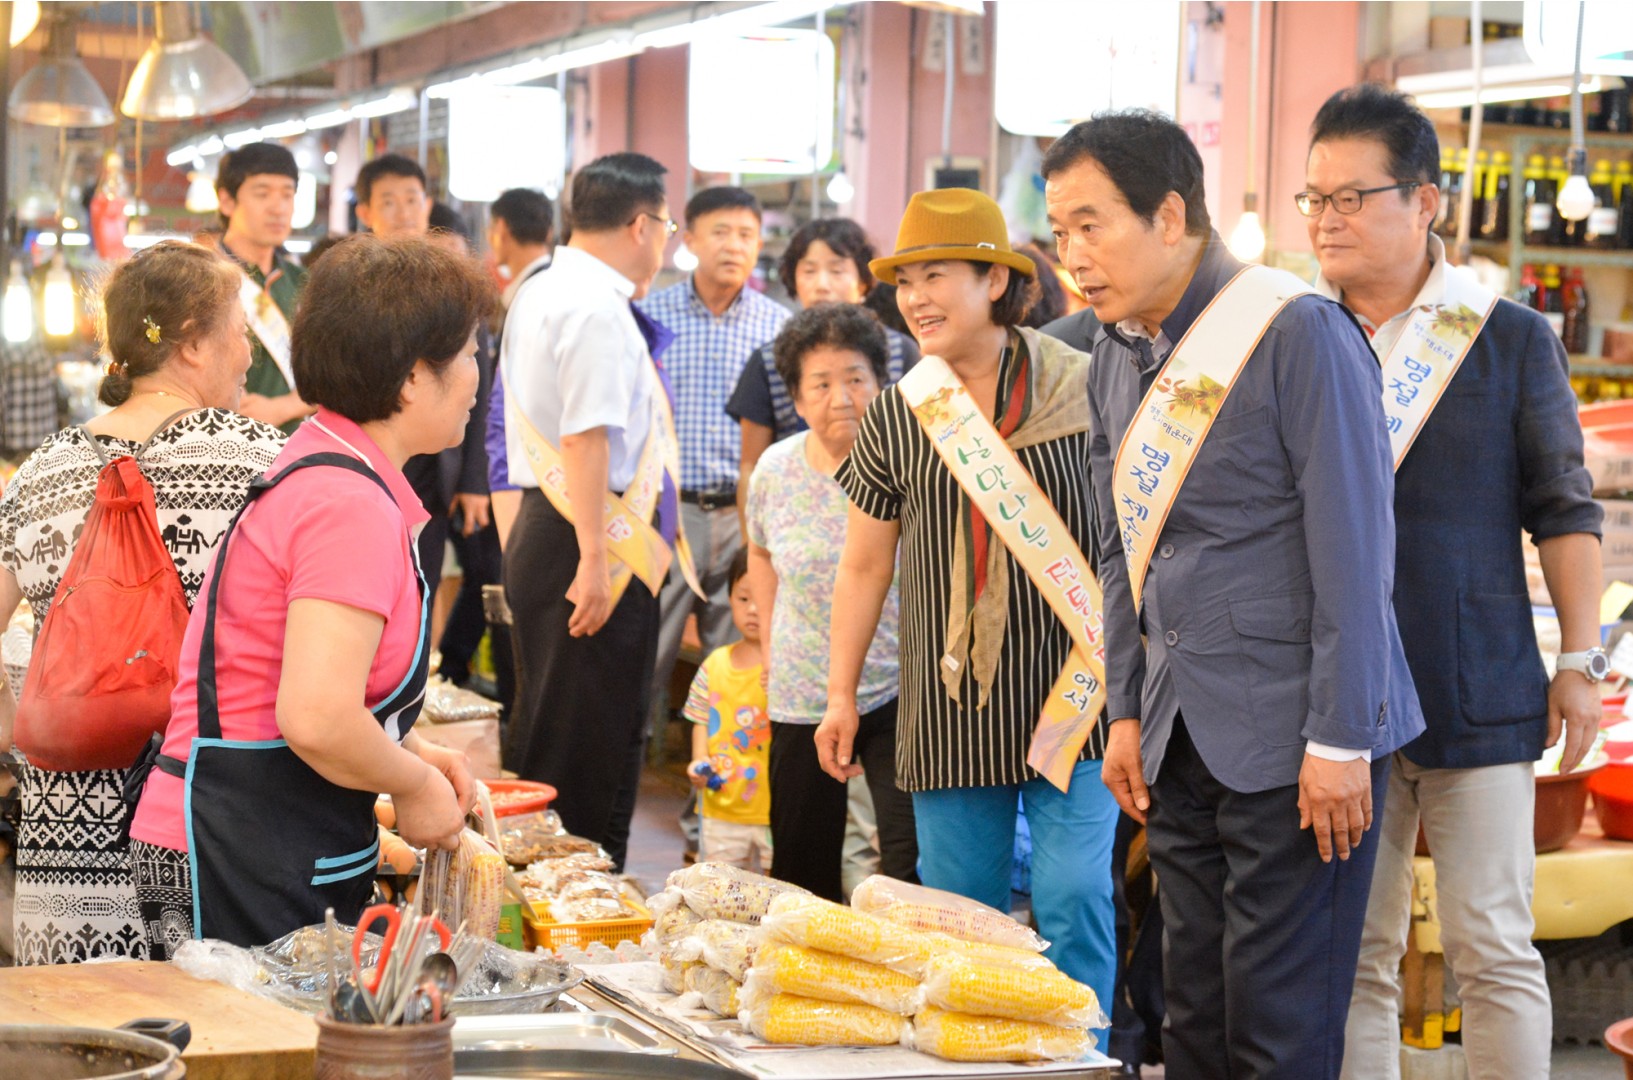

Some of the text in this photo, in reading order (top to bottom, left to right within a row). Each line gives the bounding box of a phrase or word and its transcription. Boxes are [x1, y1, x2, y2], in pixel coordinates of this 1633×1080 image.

[1388, 355, 1432, 408] 명절
[958, 437, 1049, 548] 살맛나는
[1130, 443, 1170, 497] 명절
[1065, 673, 1098, 711] 에서
